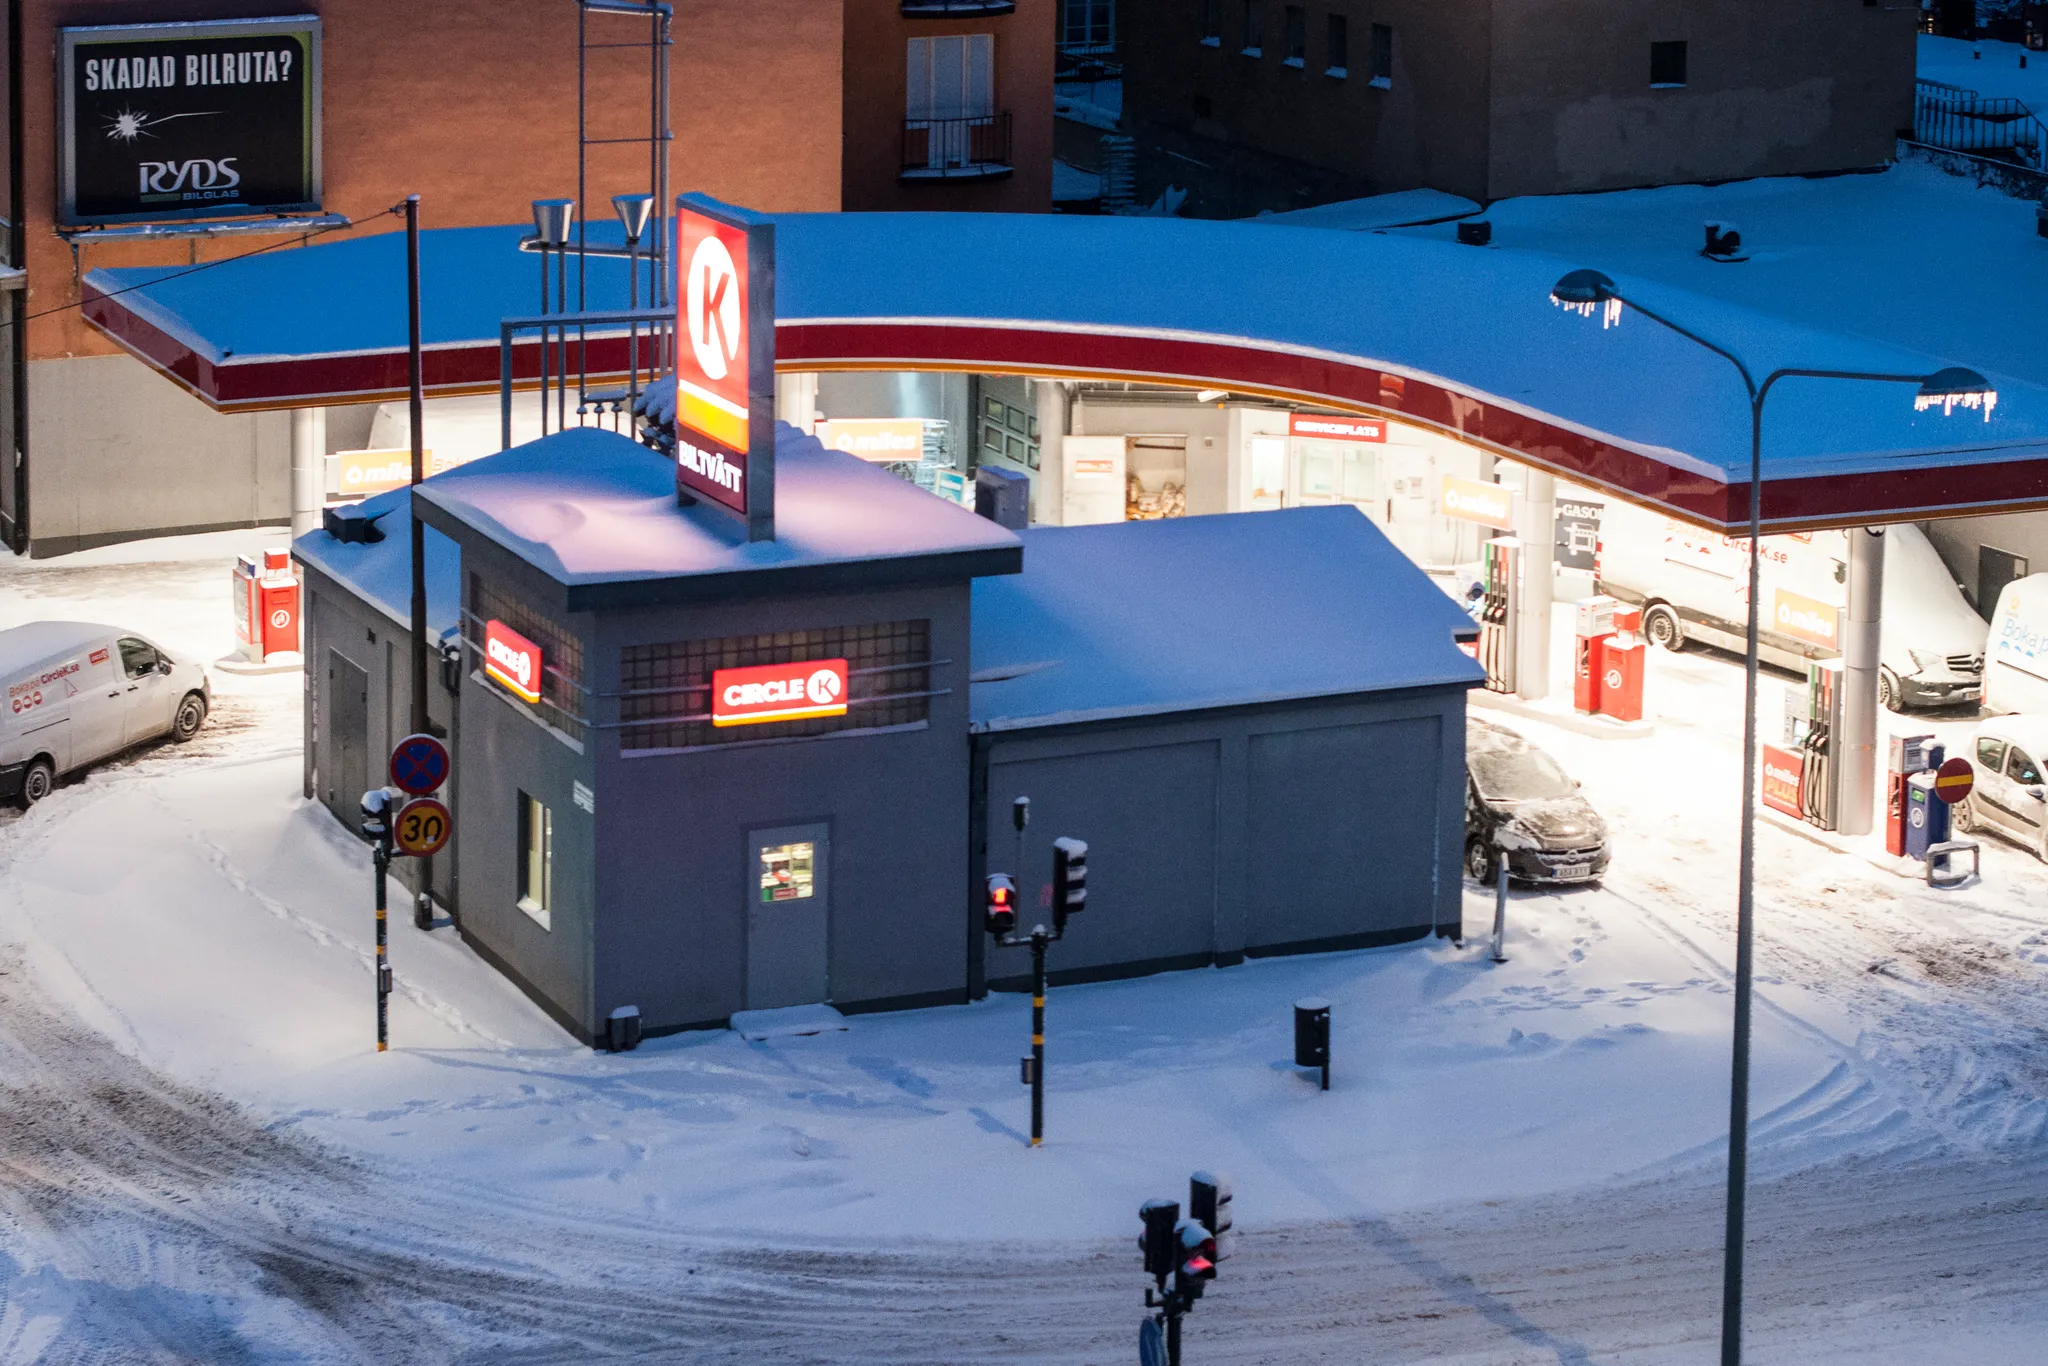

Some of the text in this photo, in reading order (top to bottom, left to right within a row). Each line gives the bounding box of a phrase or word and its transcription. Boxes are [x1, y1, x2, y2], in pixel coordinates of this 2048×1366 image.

[85, 50, 293, 91] SKADAD BILRUTA?
[139, 157, 241, 194] RYDS
[182, 189, 240, 200] BILGLAS
[679, 440, 743, 493] BILTVÄTT
[1563, 503, 1604, 520] GASO
[723, 678, 805, 707] CIRCLE
[403, 815, 443, 843] 30
